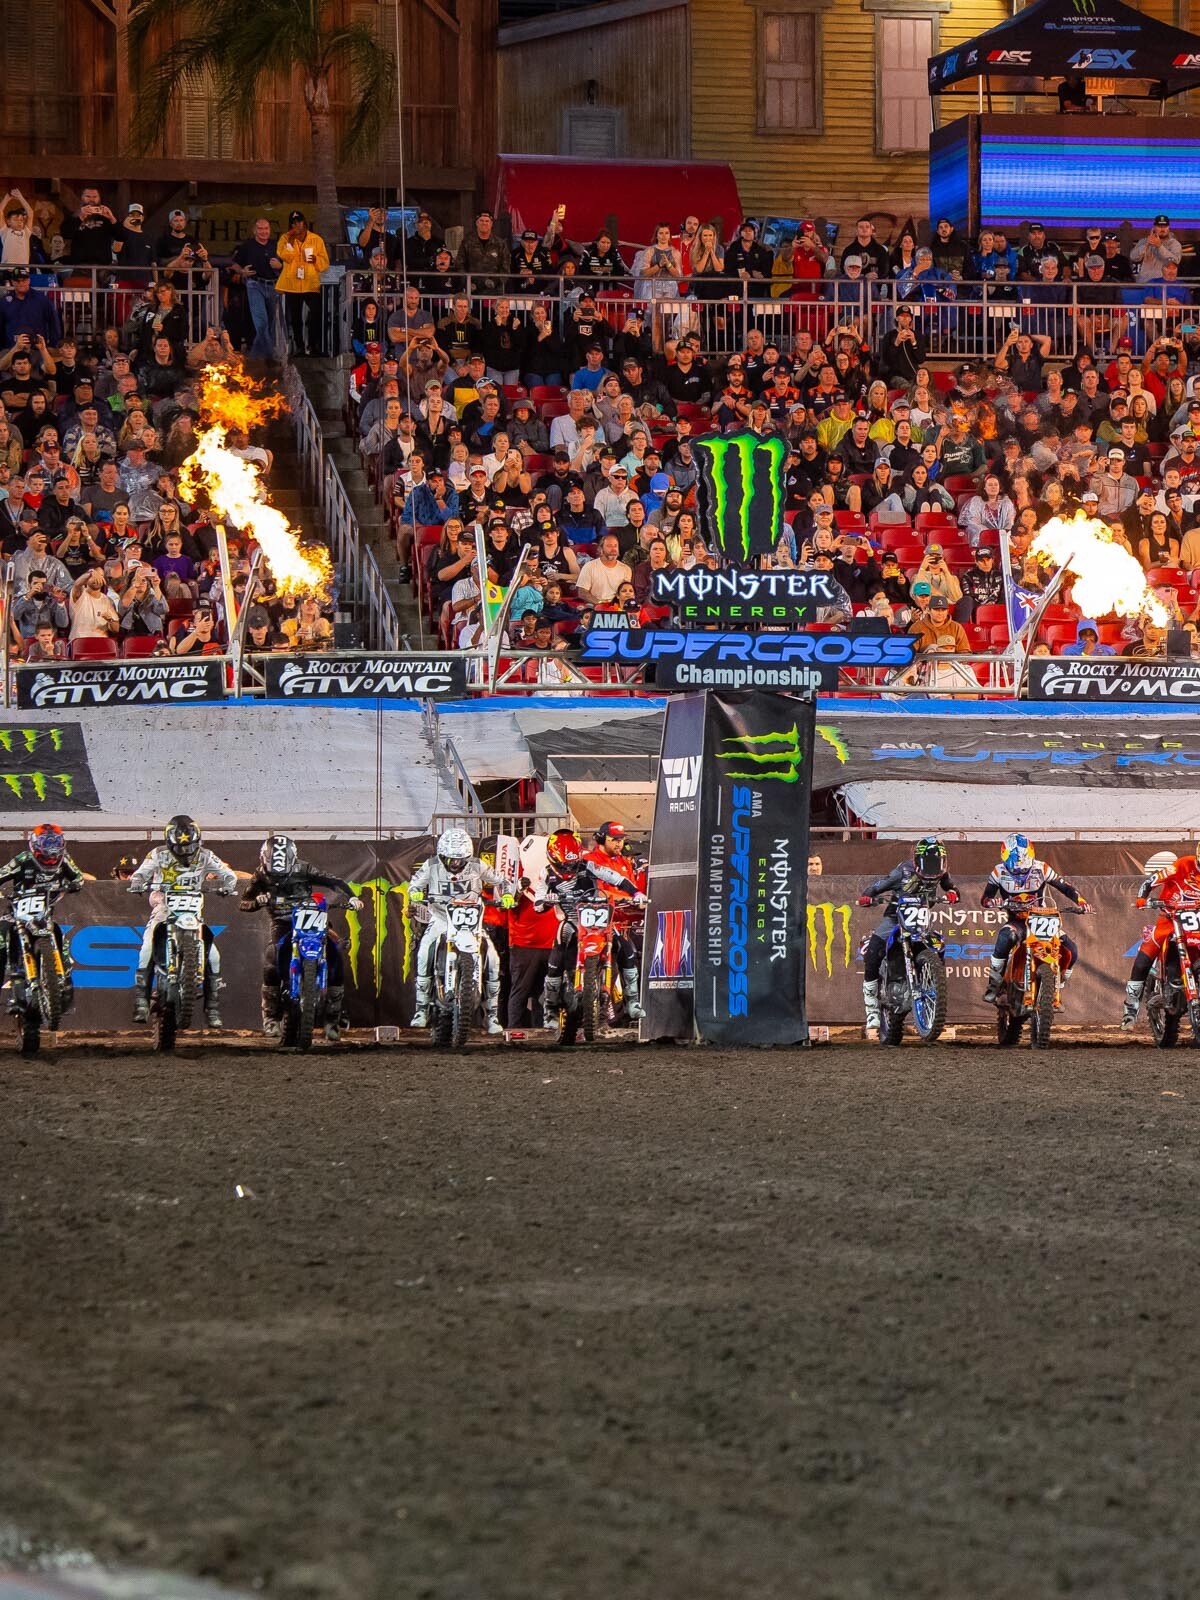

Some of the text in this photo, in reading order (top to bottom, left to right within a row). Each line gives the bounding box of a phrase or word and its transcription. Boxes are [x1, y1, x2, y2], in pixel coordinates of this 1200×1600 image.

[656, 569, 834, 601] MONSTER
[593, 614, 629, 629] AMA
[686, 606, 808, 617] ENERGY
[582, 631, 922, 664] SUPERCROSS
[59, 664, 208, 684] ROCKY MOUNTAIN
[307, 660, 452, 675] ROCKY MOUNTAIN
[676, 664, 822, 688] Championship
[1067, 662, 1121, 677] ROCKY
[670, 801, 695, 812] RACING
[751, 791, 763, 818] AMA
[16, 896, 45, 915] 86
[168, 895, 202, 911] 339
[708, 834, 725, 967] CHAMPIONSHIP
[728, 783, 752, 1018] SUPERCROSS
[757, 858, 766, 944] ENERGY
[769, 838, 791, 963] MONSTER
[294, 909, 327, 931] 174
[452, 908, 479, 926] 63
[580, 909, 609, 927] 62
[904, 907, 929, 926] 29
[1028, 917, 1060, 937] 128
